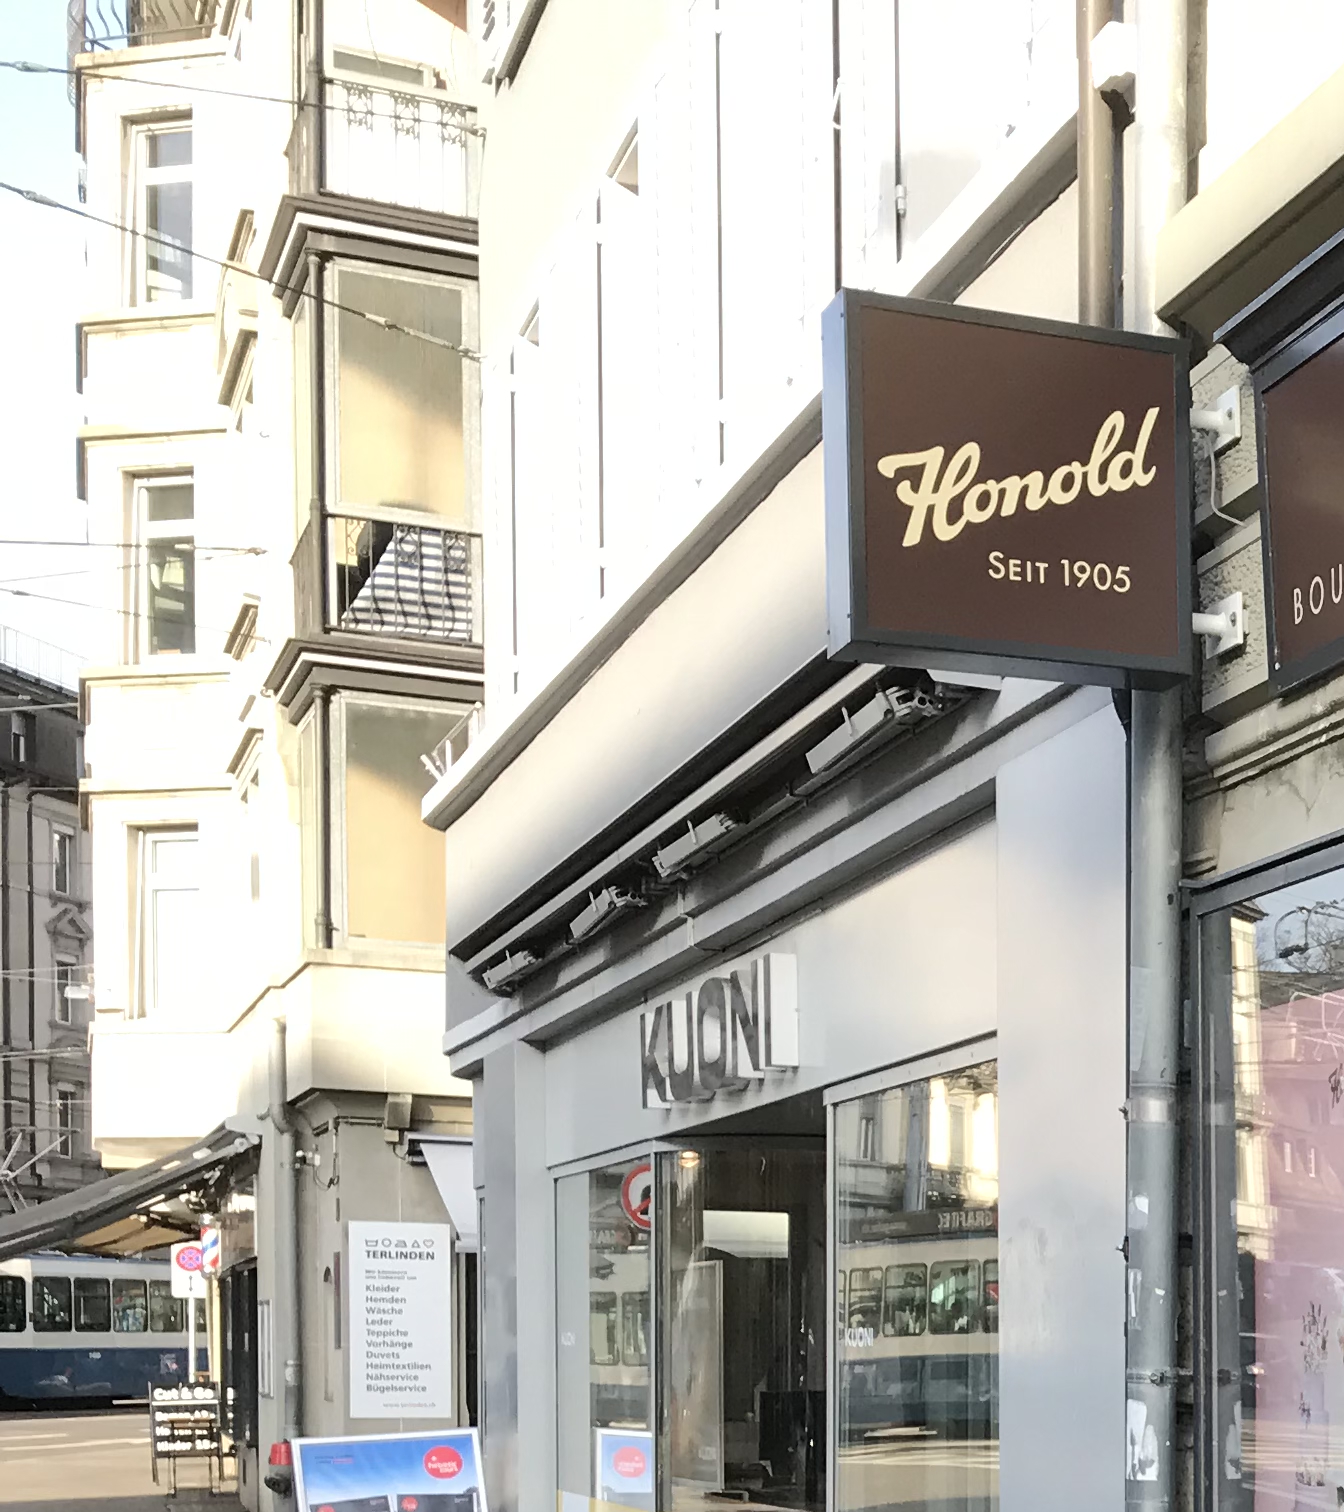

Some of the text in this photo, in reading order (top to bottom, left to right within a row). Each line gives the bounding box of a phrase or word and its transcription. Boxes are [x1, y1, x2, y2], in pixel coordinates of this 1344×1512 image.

[877, 406, 1160, 549] Honold
[1061, 558, 1132, 594] 1905
[640, 953, 798, 1110] KUONI
[365, 1250, 436, 1261] TERLINDEN
[365, 1284, 401, 1293] Kleider
[365, 1295, 407, 1304] Hemden
[365, 1306, 404, 1315] Wäsche
[365, 1317, 393, 1326] Leder
[366, 1328, 409, 1338] Teppiche
[844, 1327, 875, 1348] KUONI
[366, 1339, 413, 1350] Vorhänge
[366, 1350, 401, 1360] Duvets
[366, 1361, 432, 1371] Heimtextilien
[366, 1372, 419, 1382] Nähservice
[366, 1383, 427, 1394] Bügelservice
